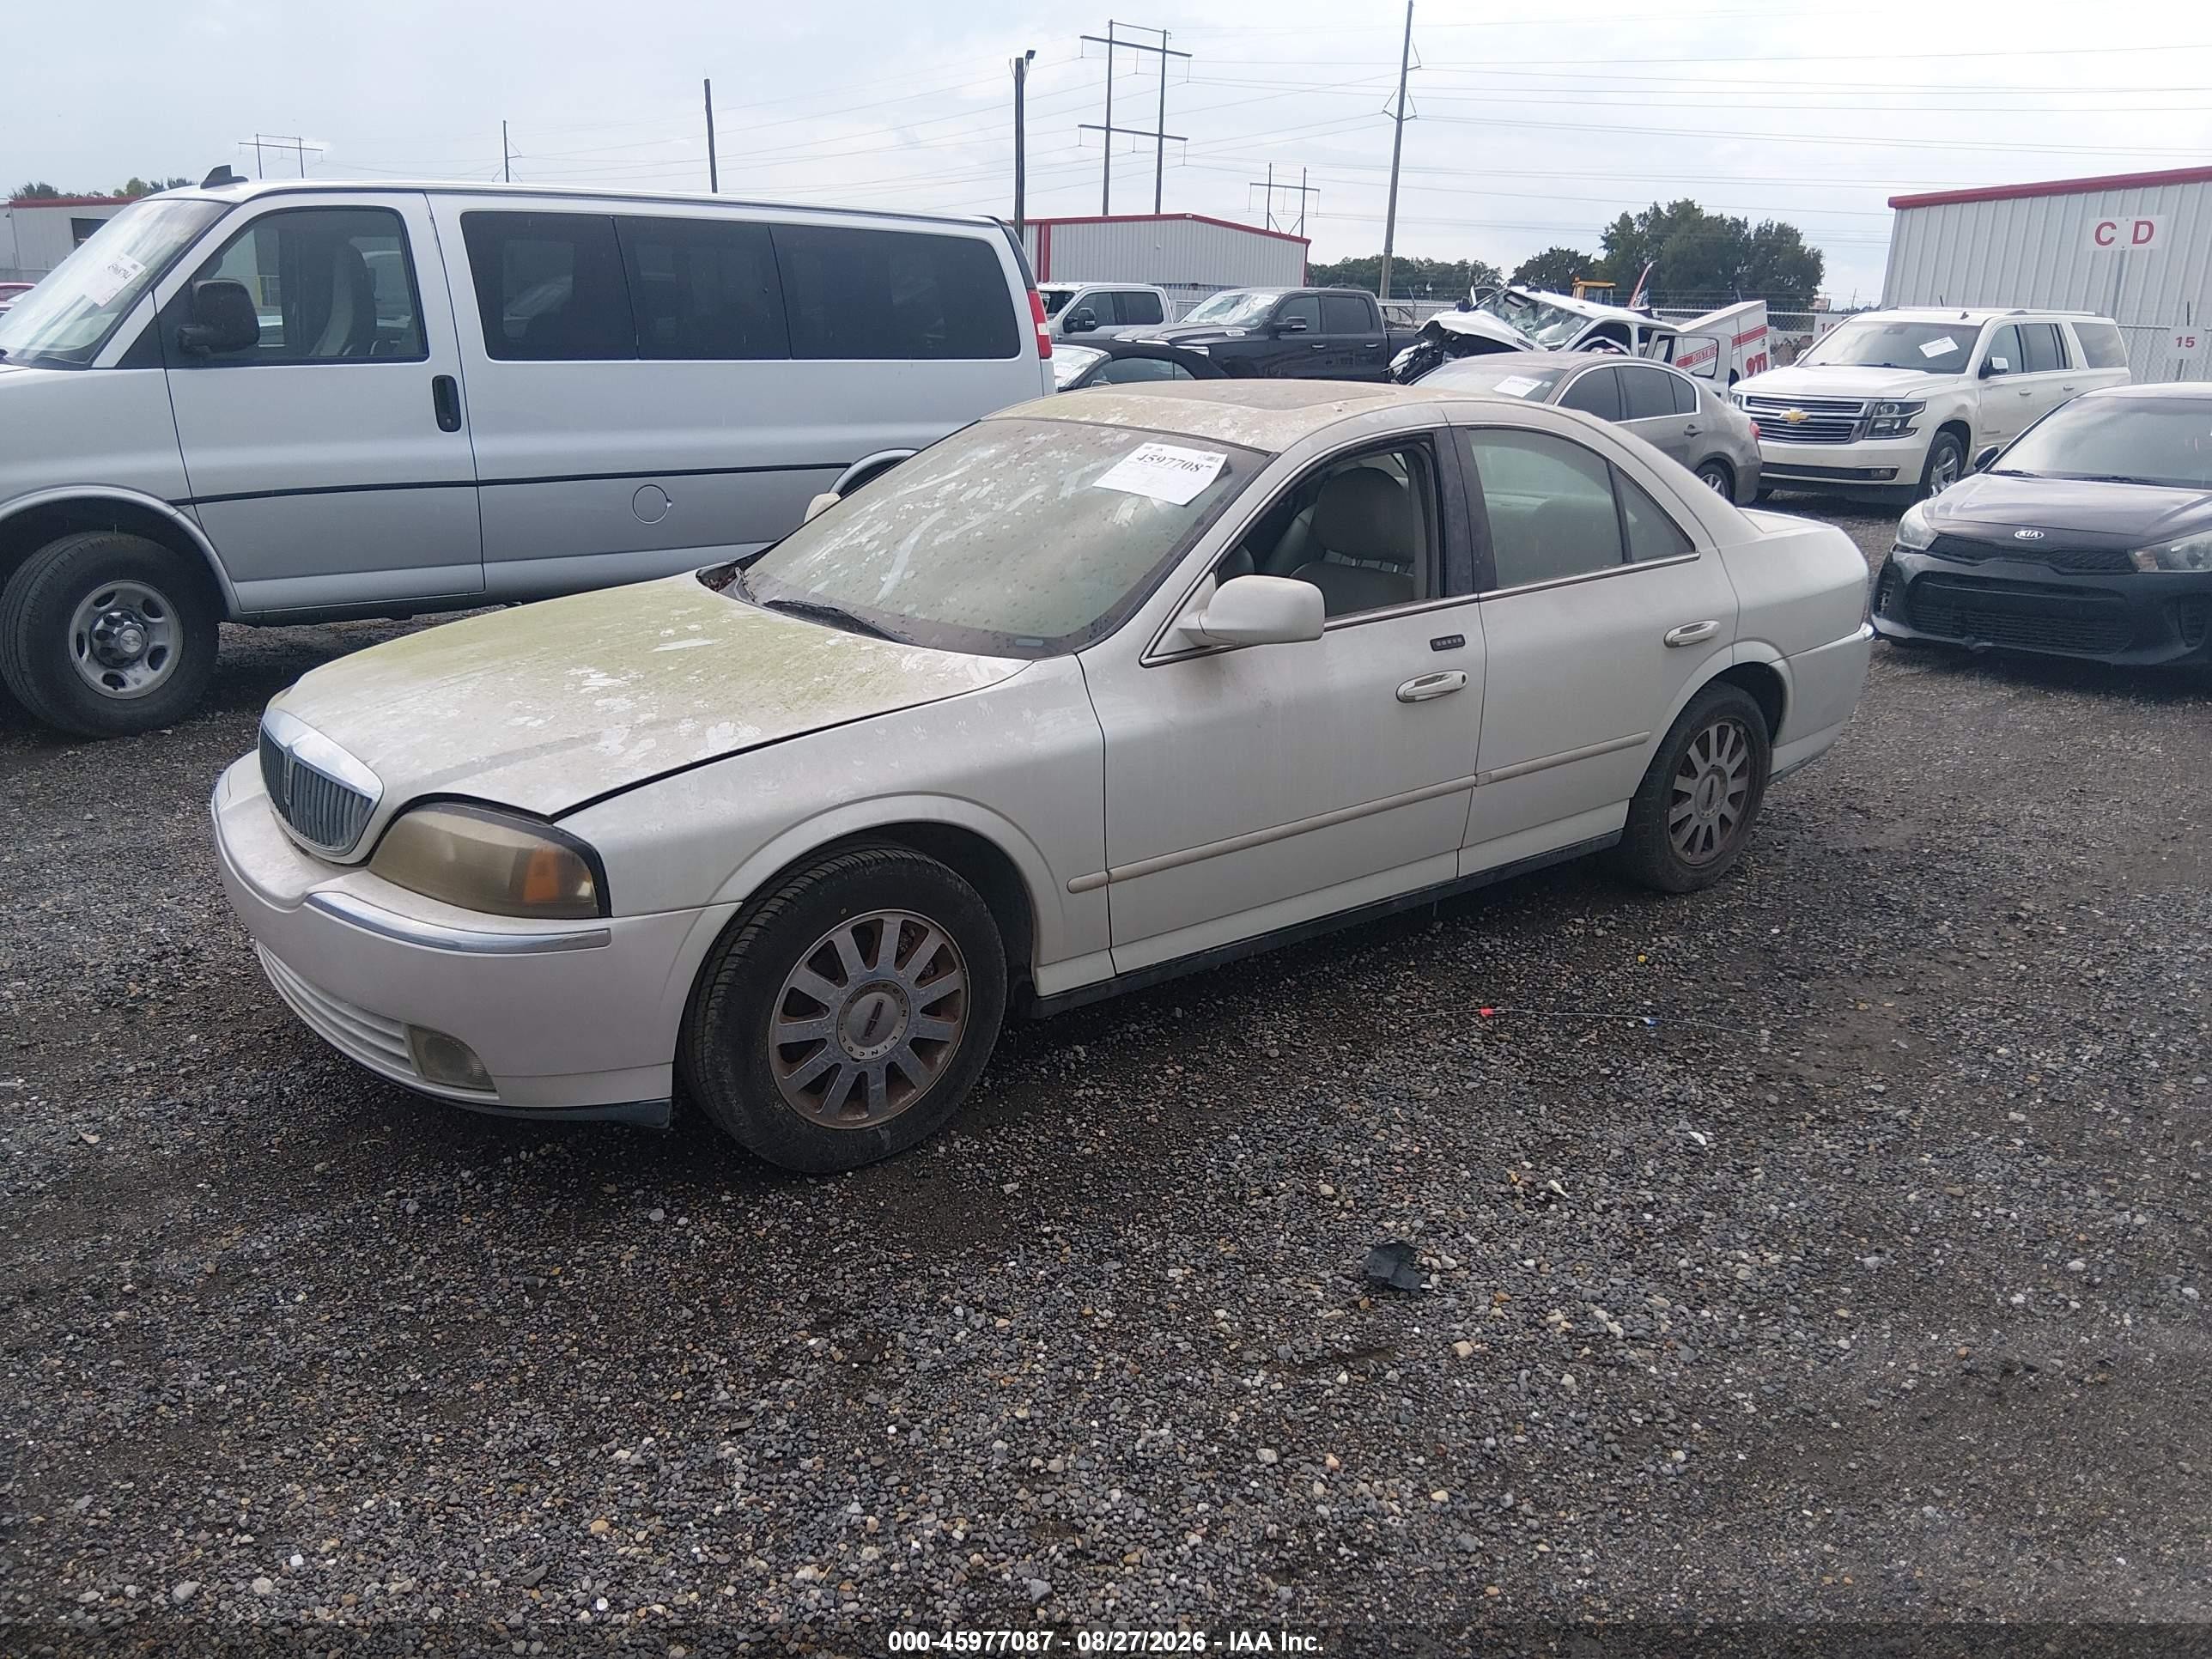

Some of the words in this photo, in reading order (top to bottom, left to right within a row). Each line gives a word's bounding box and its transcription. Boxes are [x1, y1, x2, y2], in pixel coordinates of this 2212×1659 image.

[2094, 221, 2117, 246] C
[2131, 220, 2154, 246] D
[2174, 336, 2196, 349] 15
